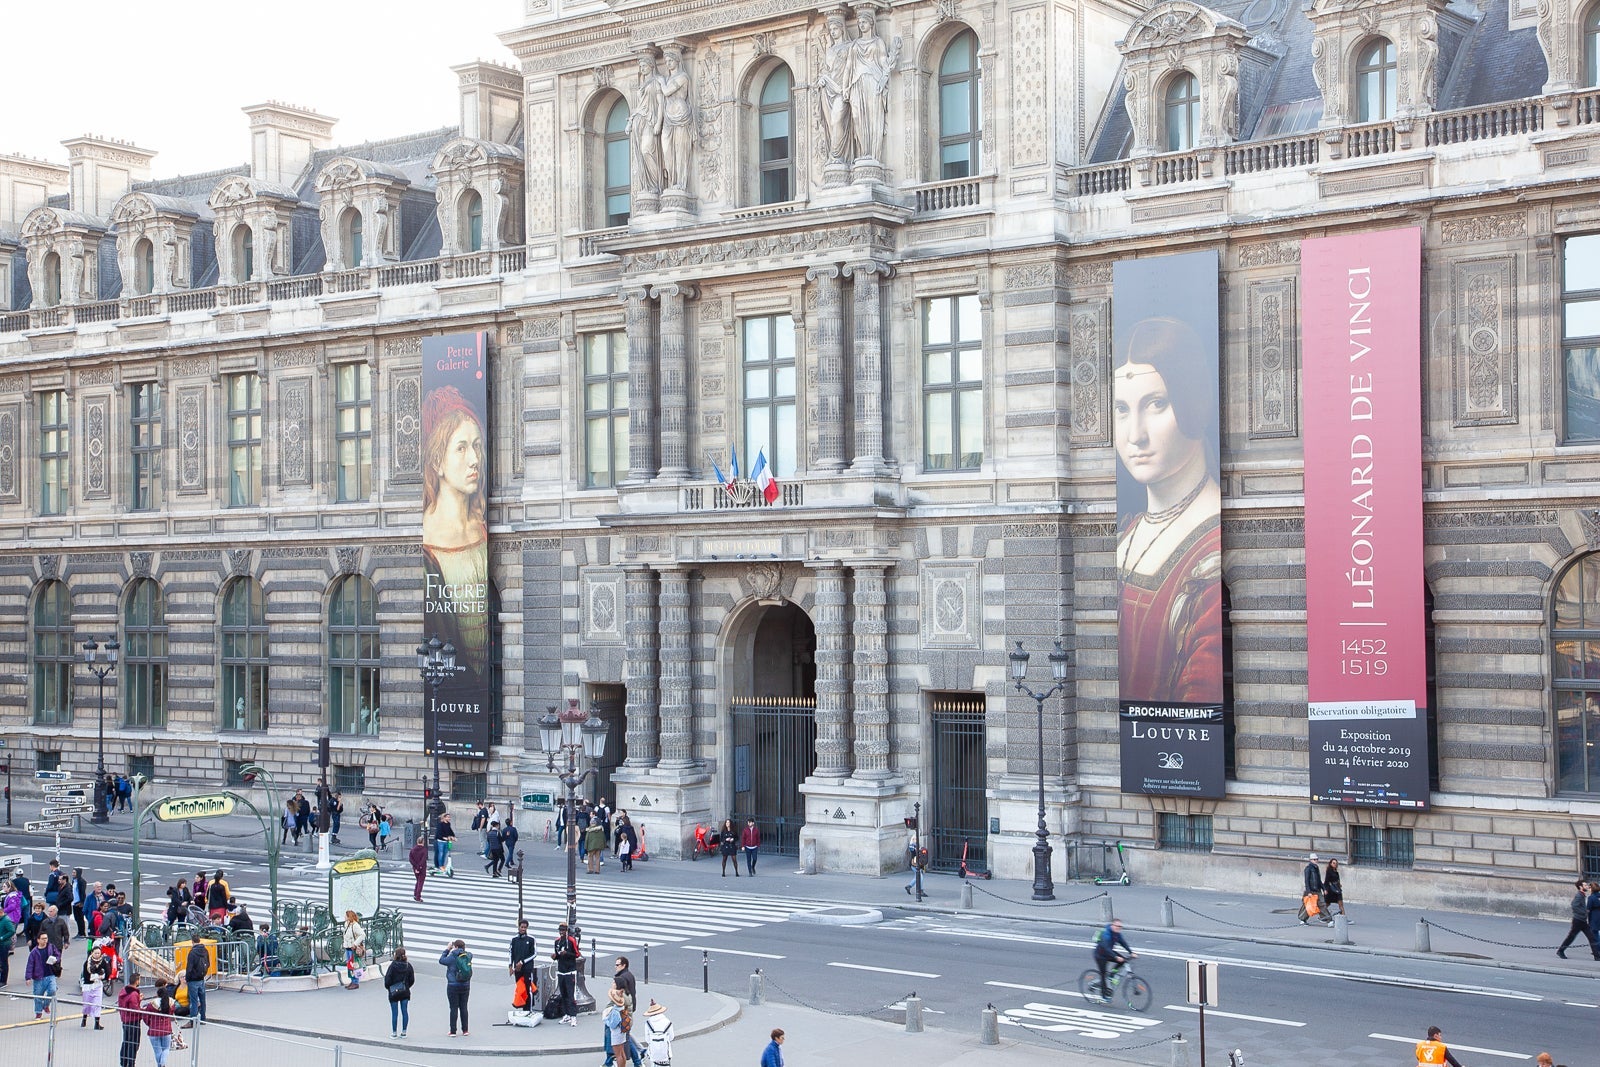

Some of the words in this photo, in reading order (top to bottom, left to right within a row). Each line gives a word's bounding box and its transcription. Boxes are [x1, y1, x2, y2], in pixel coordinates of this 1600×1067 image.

[1348, 267, 1372, 363] VINCI
[1350, 373, 1373, 422] DE
[1345, 433, 1374, 609] LÉONARD
[426, 573, 486, 599] FIGURE
[425, 600, 486, 613] D'ARTISTE
[1341, 639, 1388, 655] 1452
[1341, 659, 1388, 676] 1519
[430, 698, 480, 714] LOUVRE
[1128, 706, 1214, 719] PROCHAINEMENT
[1309, 706, 1359, 717] Réservation
[1360, 705, 1408, 717] obligatoire
[1131, 721, 1210, 741] LOUVRE
[1340, 729, 1391, 743] Exposition
[1322, 741, 1335, 752] du
[1337, 744, 1349, 755] 24
[1350, 743, 1386, 754] octobre
[1388, 746, 1411, 758] 2019
[1324, 757, 1337, 765] au
[1338, 758, 1350, 768] 24
[1352, 755, 1384, 767] février
[1386, 760, 1409, 768] 2020
[169, 799, 225, 816] METROPOLITAIN
